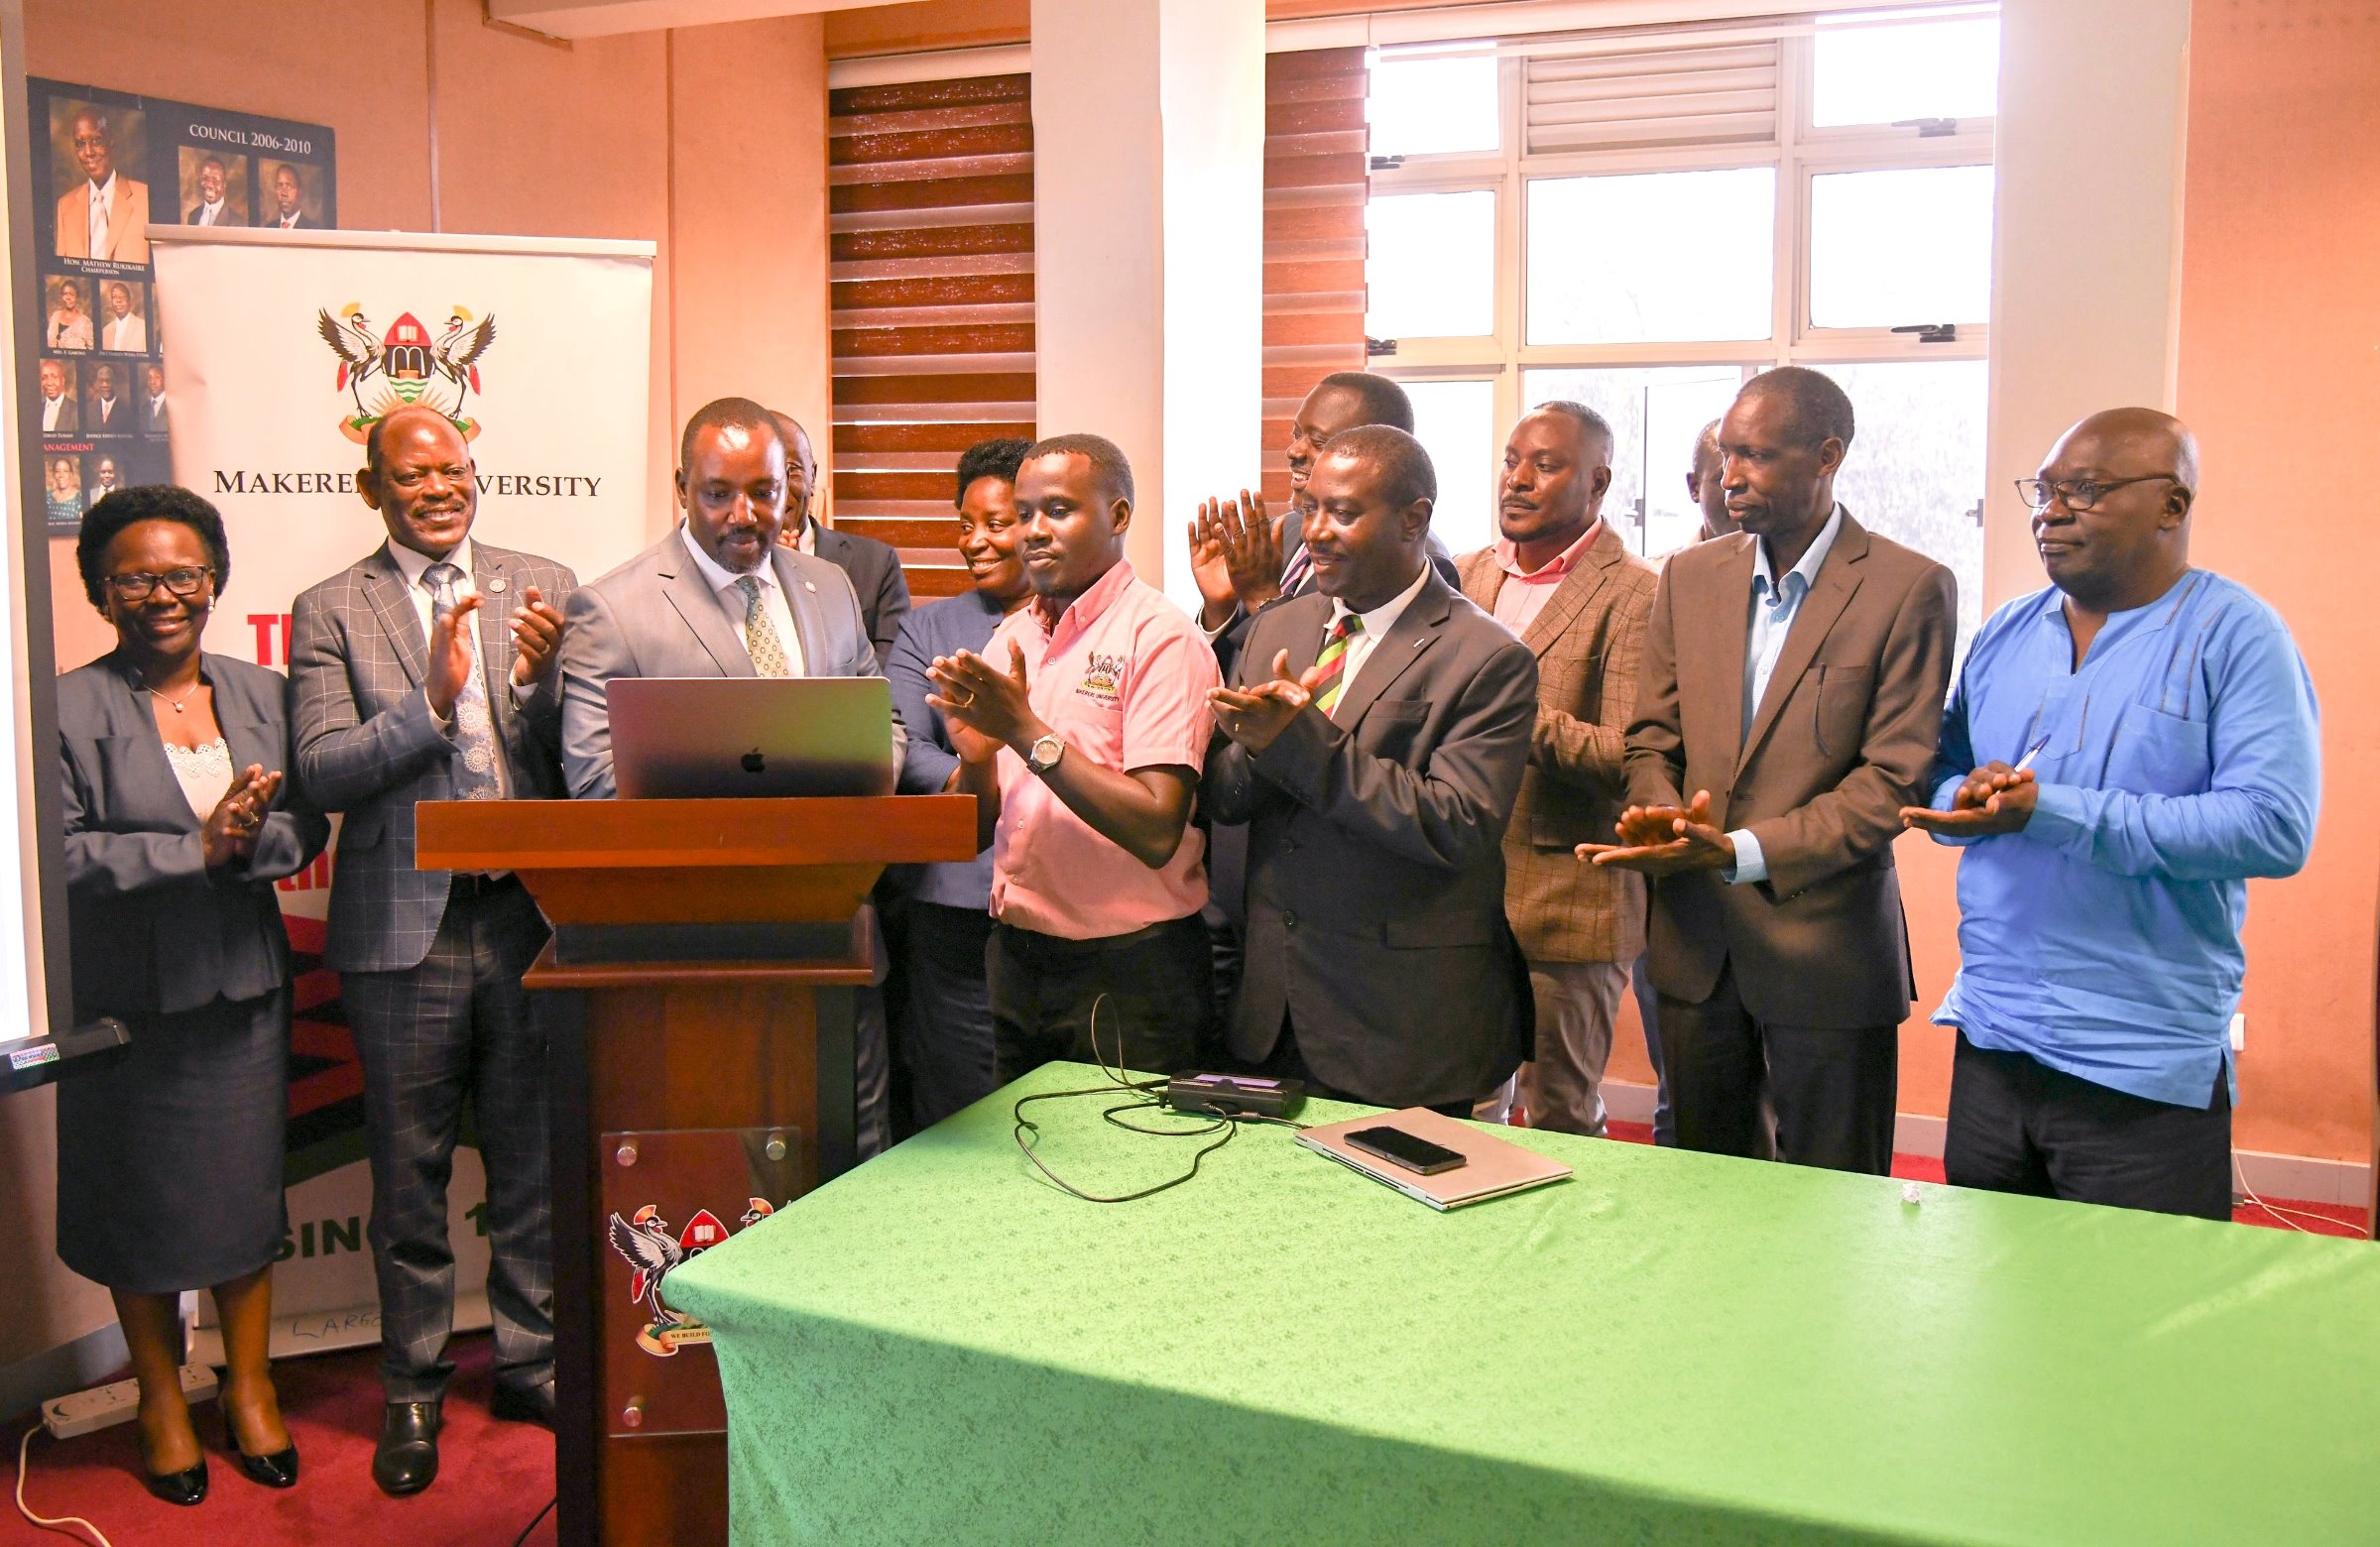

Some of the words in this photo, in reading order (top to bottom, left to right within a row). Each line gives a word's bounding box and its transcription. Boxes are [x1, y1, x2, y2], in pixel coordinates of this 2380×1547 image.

[189, 124, 248, 145] COUNCIL
[251, 132, 311, 155] 2006-2010
[81, 267, 120, 276] CHAIRPERSON
[44, 443, 94, 452] ANAGEMENT
[214, 470, 361, 494] MAKERE
[475, 475, 601, 497] VERSITY
[273, 1216, 361, 1261] SIN
